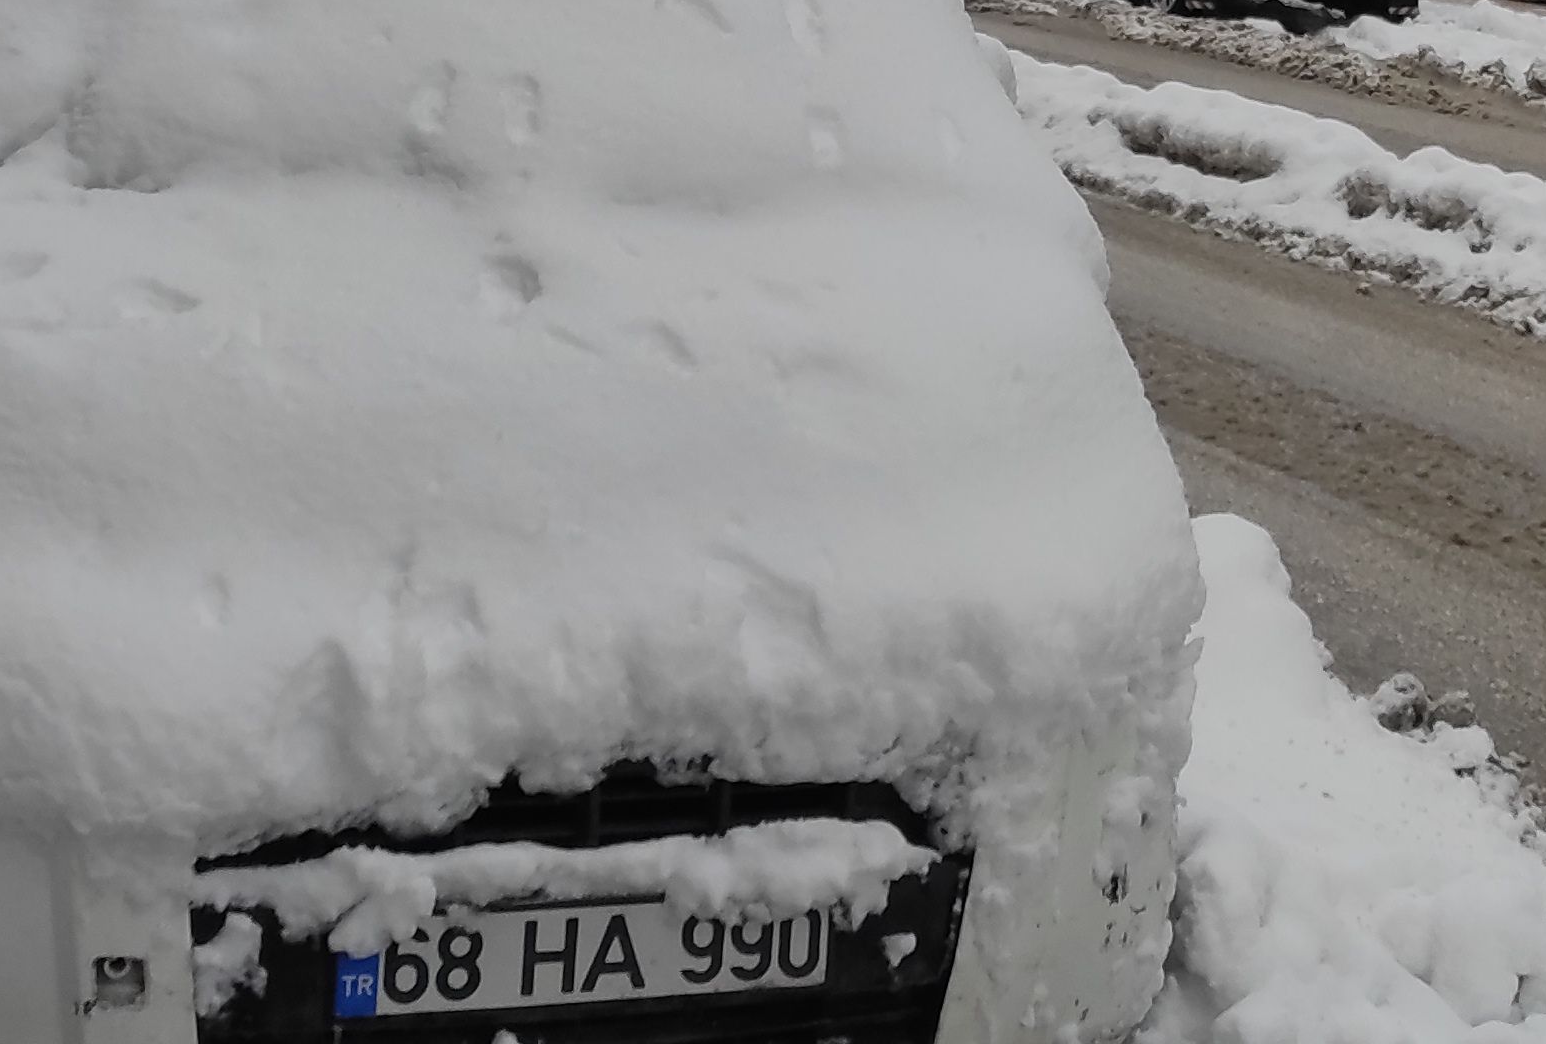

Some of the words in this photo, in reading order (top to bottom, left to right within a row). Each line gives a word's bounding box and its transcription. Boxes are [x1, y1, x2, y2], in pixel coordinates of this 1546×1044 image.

[341, 974, 376, 998] TR
[382, 924, 484, 1006] 68
[519, 913, 647, 998] HA
[678, 906, 824, 986] 990
